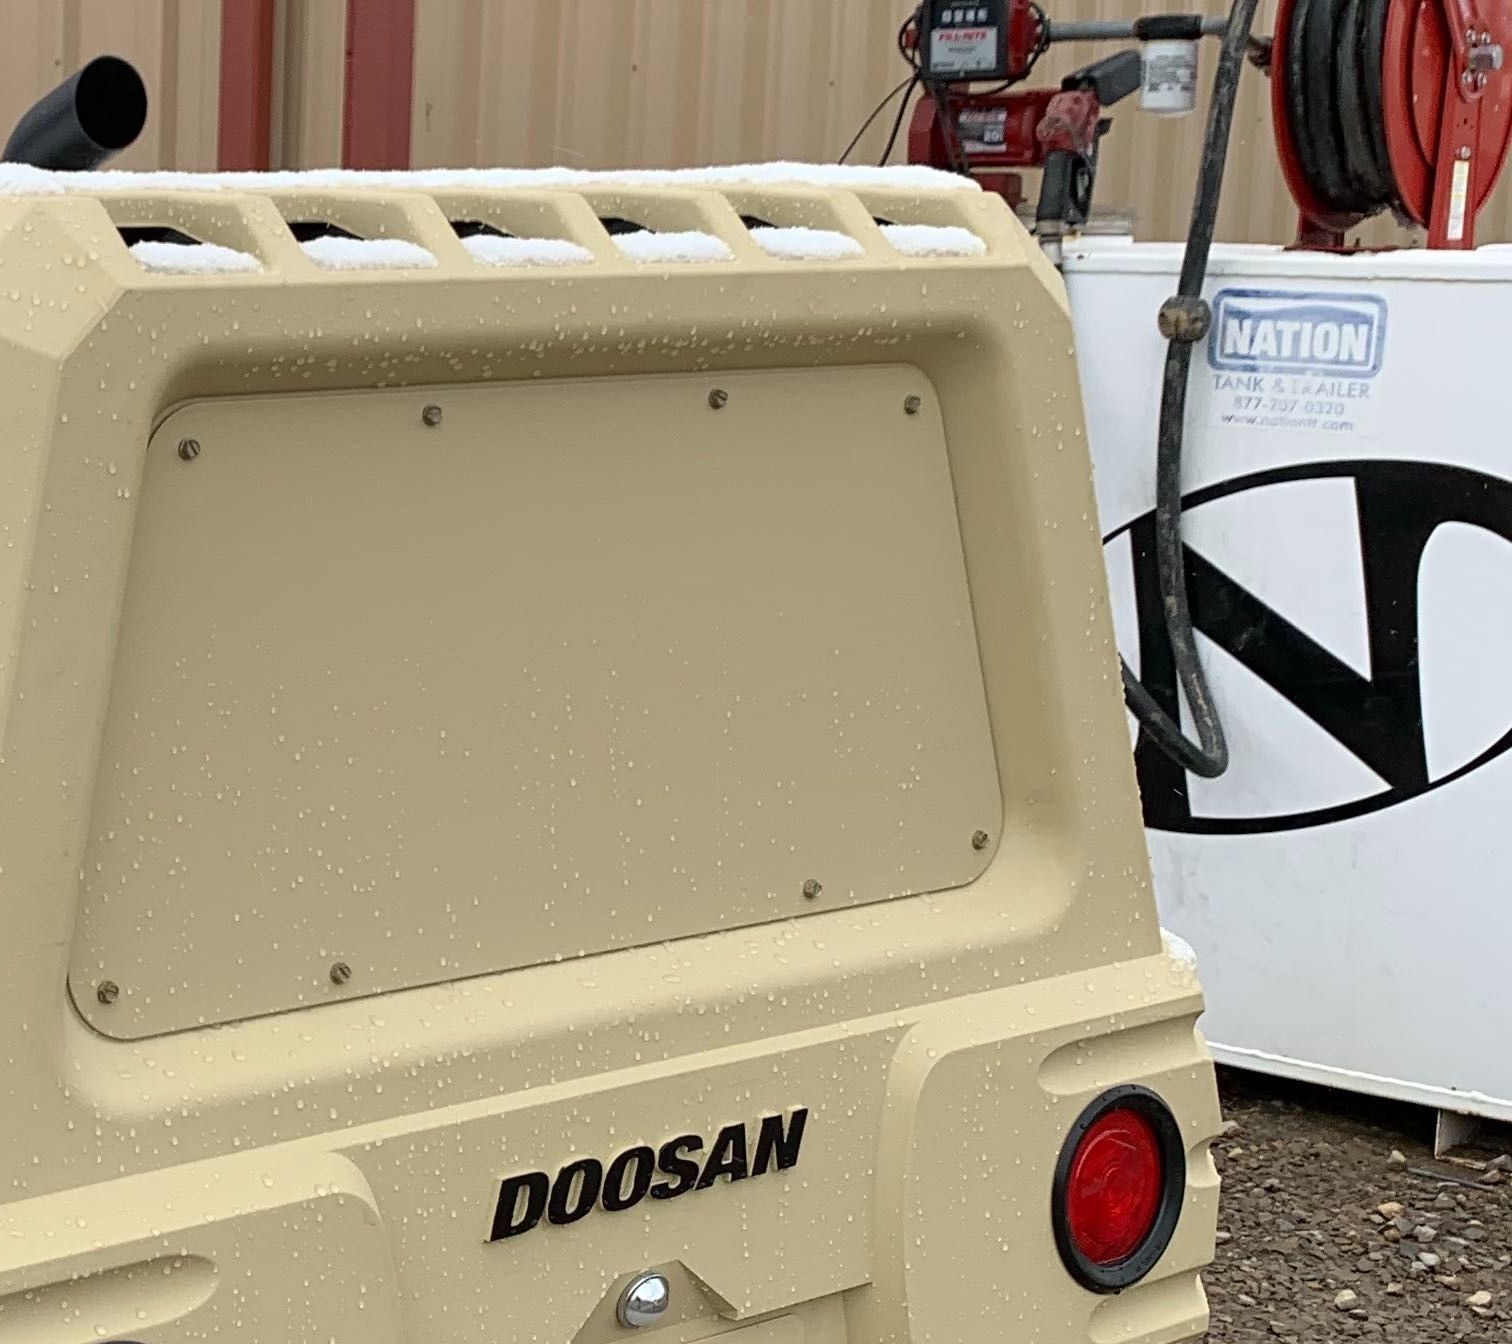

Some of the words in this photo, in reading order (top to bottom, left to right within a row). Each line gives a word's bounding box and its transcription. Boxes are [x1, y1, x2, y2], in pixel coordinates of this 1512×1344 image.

[1223, 317, 1370, 362] NATION
[1212, 373, 1265, 394] TANK
[486, 1105, 809, 1243] DOOSAN
